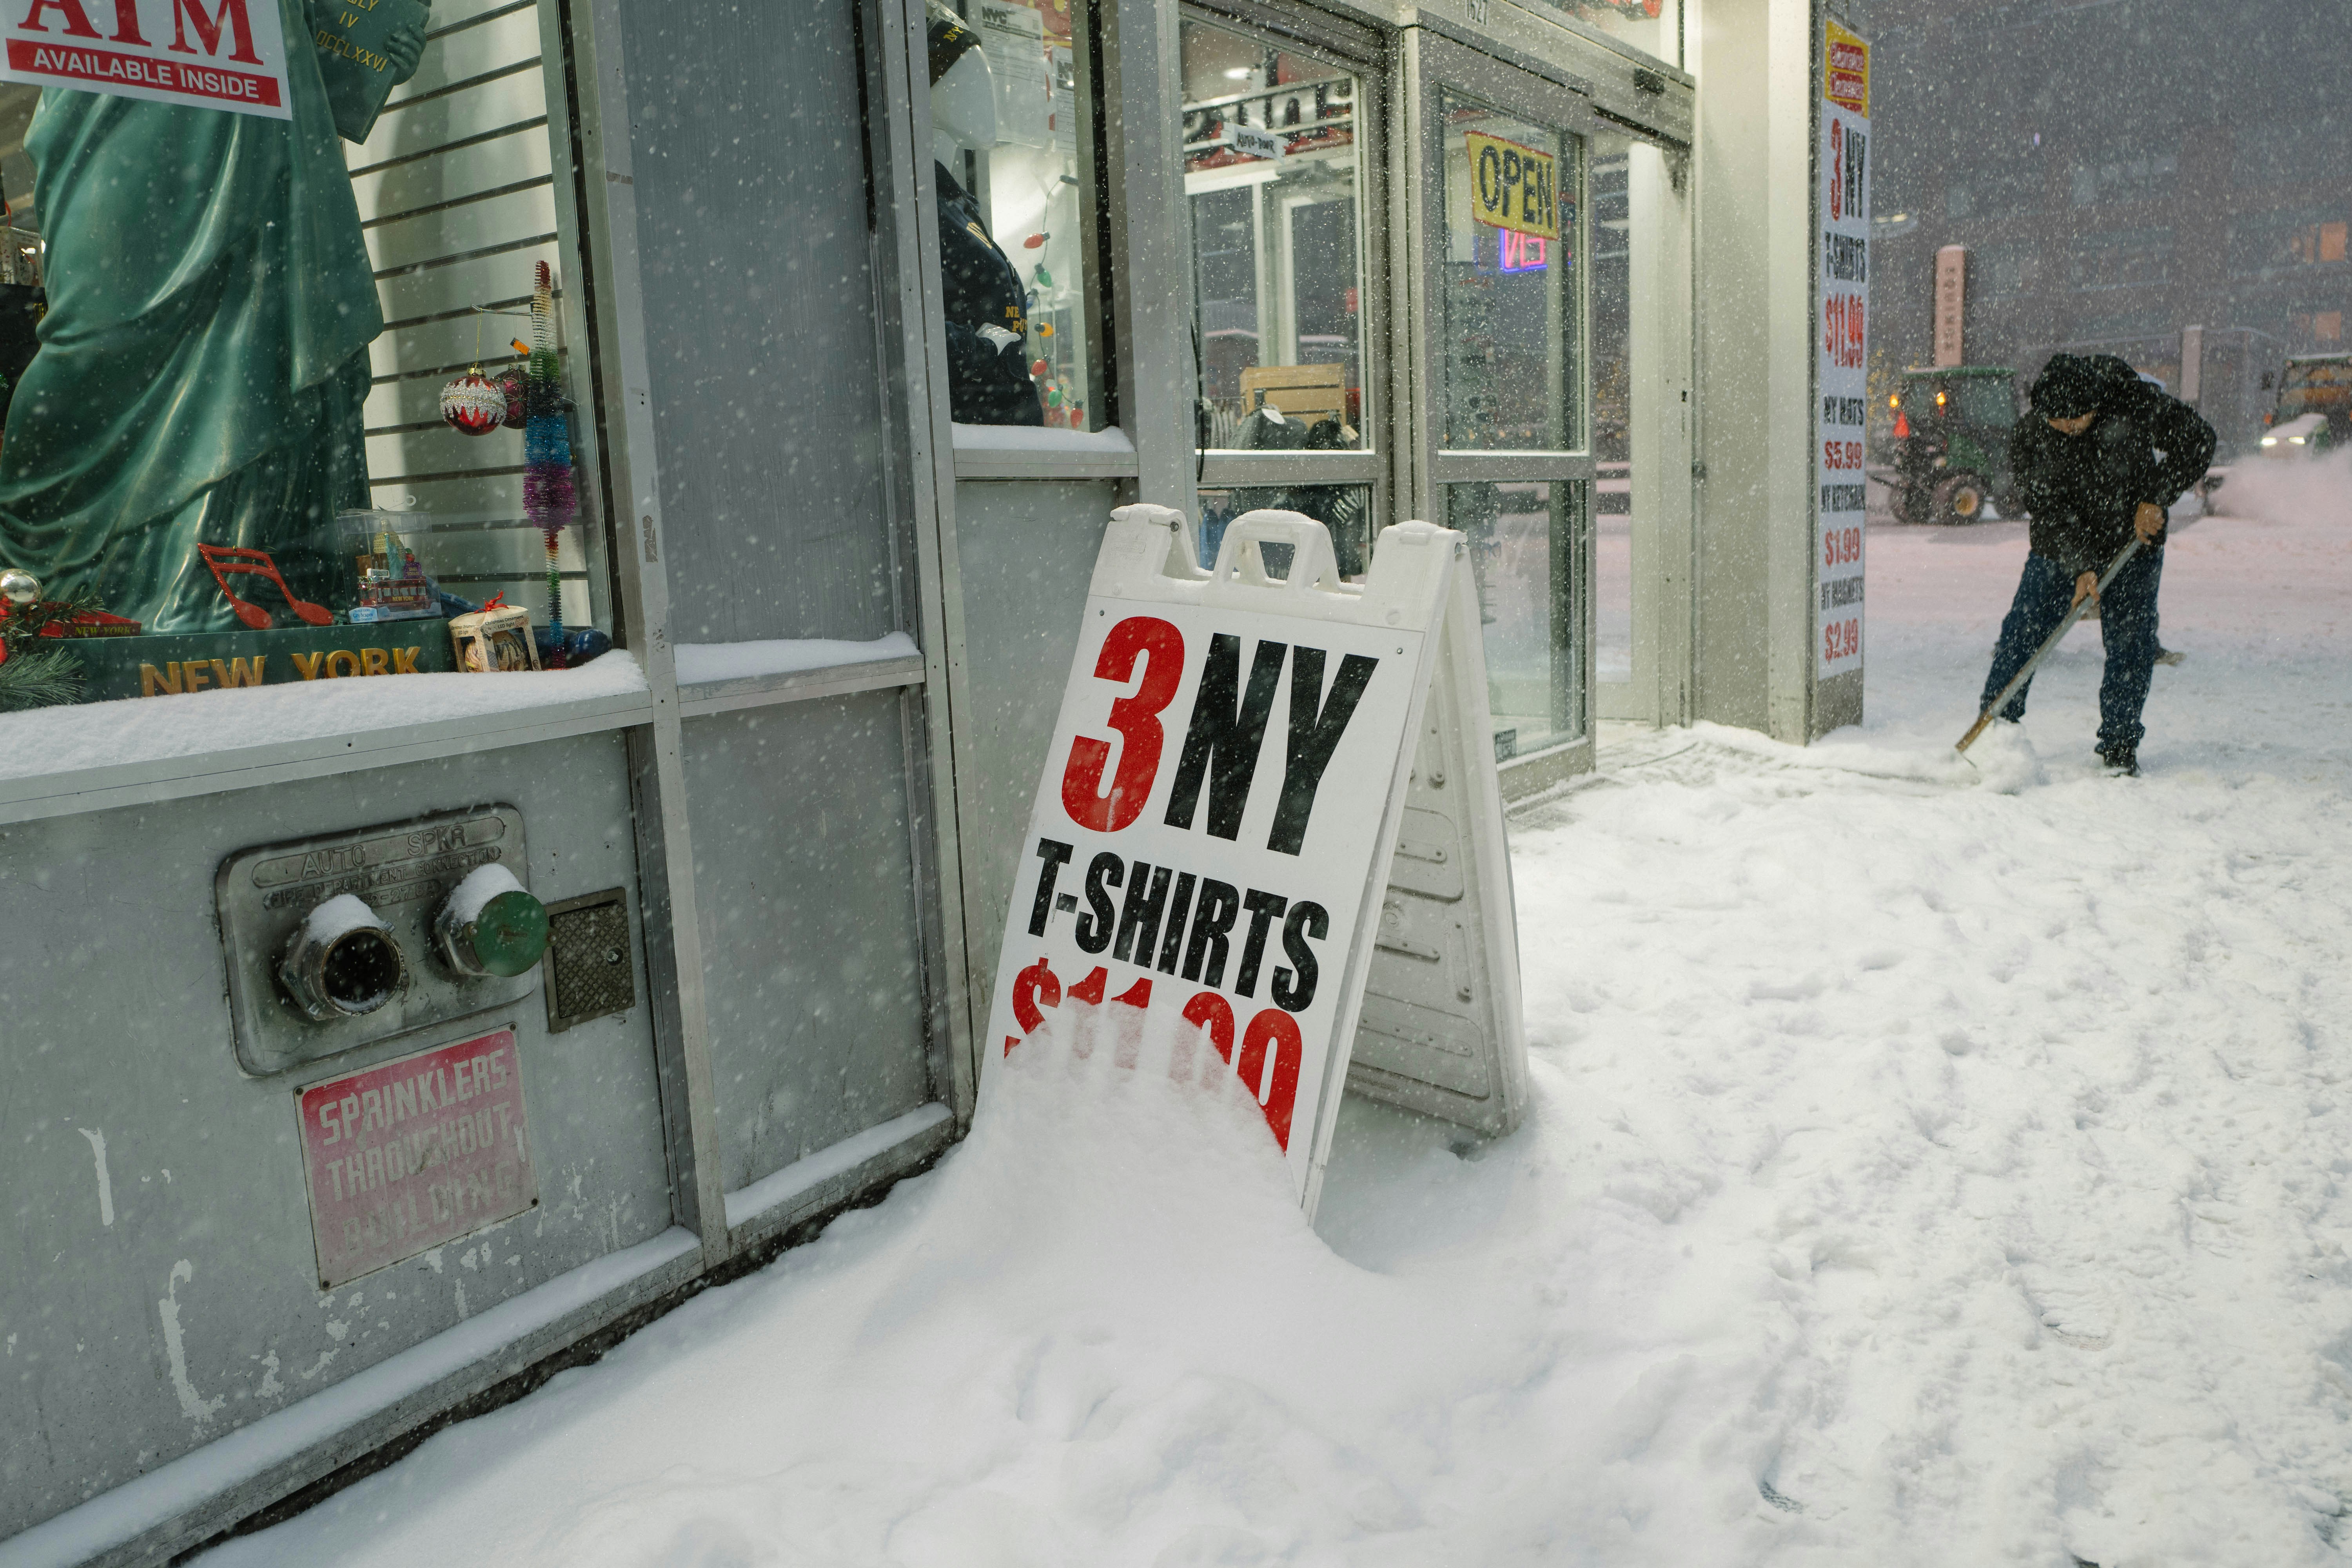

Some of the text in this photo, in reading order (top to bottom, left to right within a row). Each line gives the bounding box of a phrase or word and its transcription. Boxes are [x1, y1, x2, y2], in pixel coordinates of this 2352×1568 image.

[339, 11, 358, 28] IV
[33, 48, 259, 98] AVAILABLE INSIDE
[1479, 145, 1553, 230] OPEN
[1825, 439, 1862, 471] $5.99
[1825, 527, 1860, 567] $1.99
[75, 626, 132, 635] NEW YORK
[1825, 618, 1858, 664] $2.99
[291, 646, 421, 681] YORK
[272, 849, 497, 905] FIRE DEPARTMENT CONNECTION
[301, 825, 466, 879] AUTO SPKR
[1027, 837, 1330, 1013] T-SHIRTS
[319, 1049, 507, 1146] SPRINKLERS
[326, 1101, 510, 1201] THROUGHOUT
[343, 1160, 512, 1254] BUILDING
